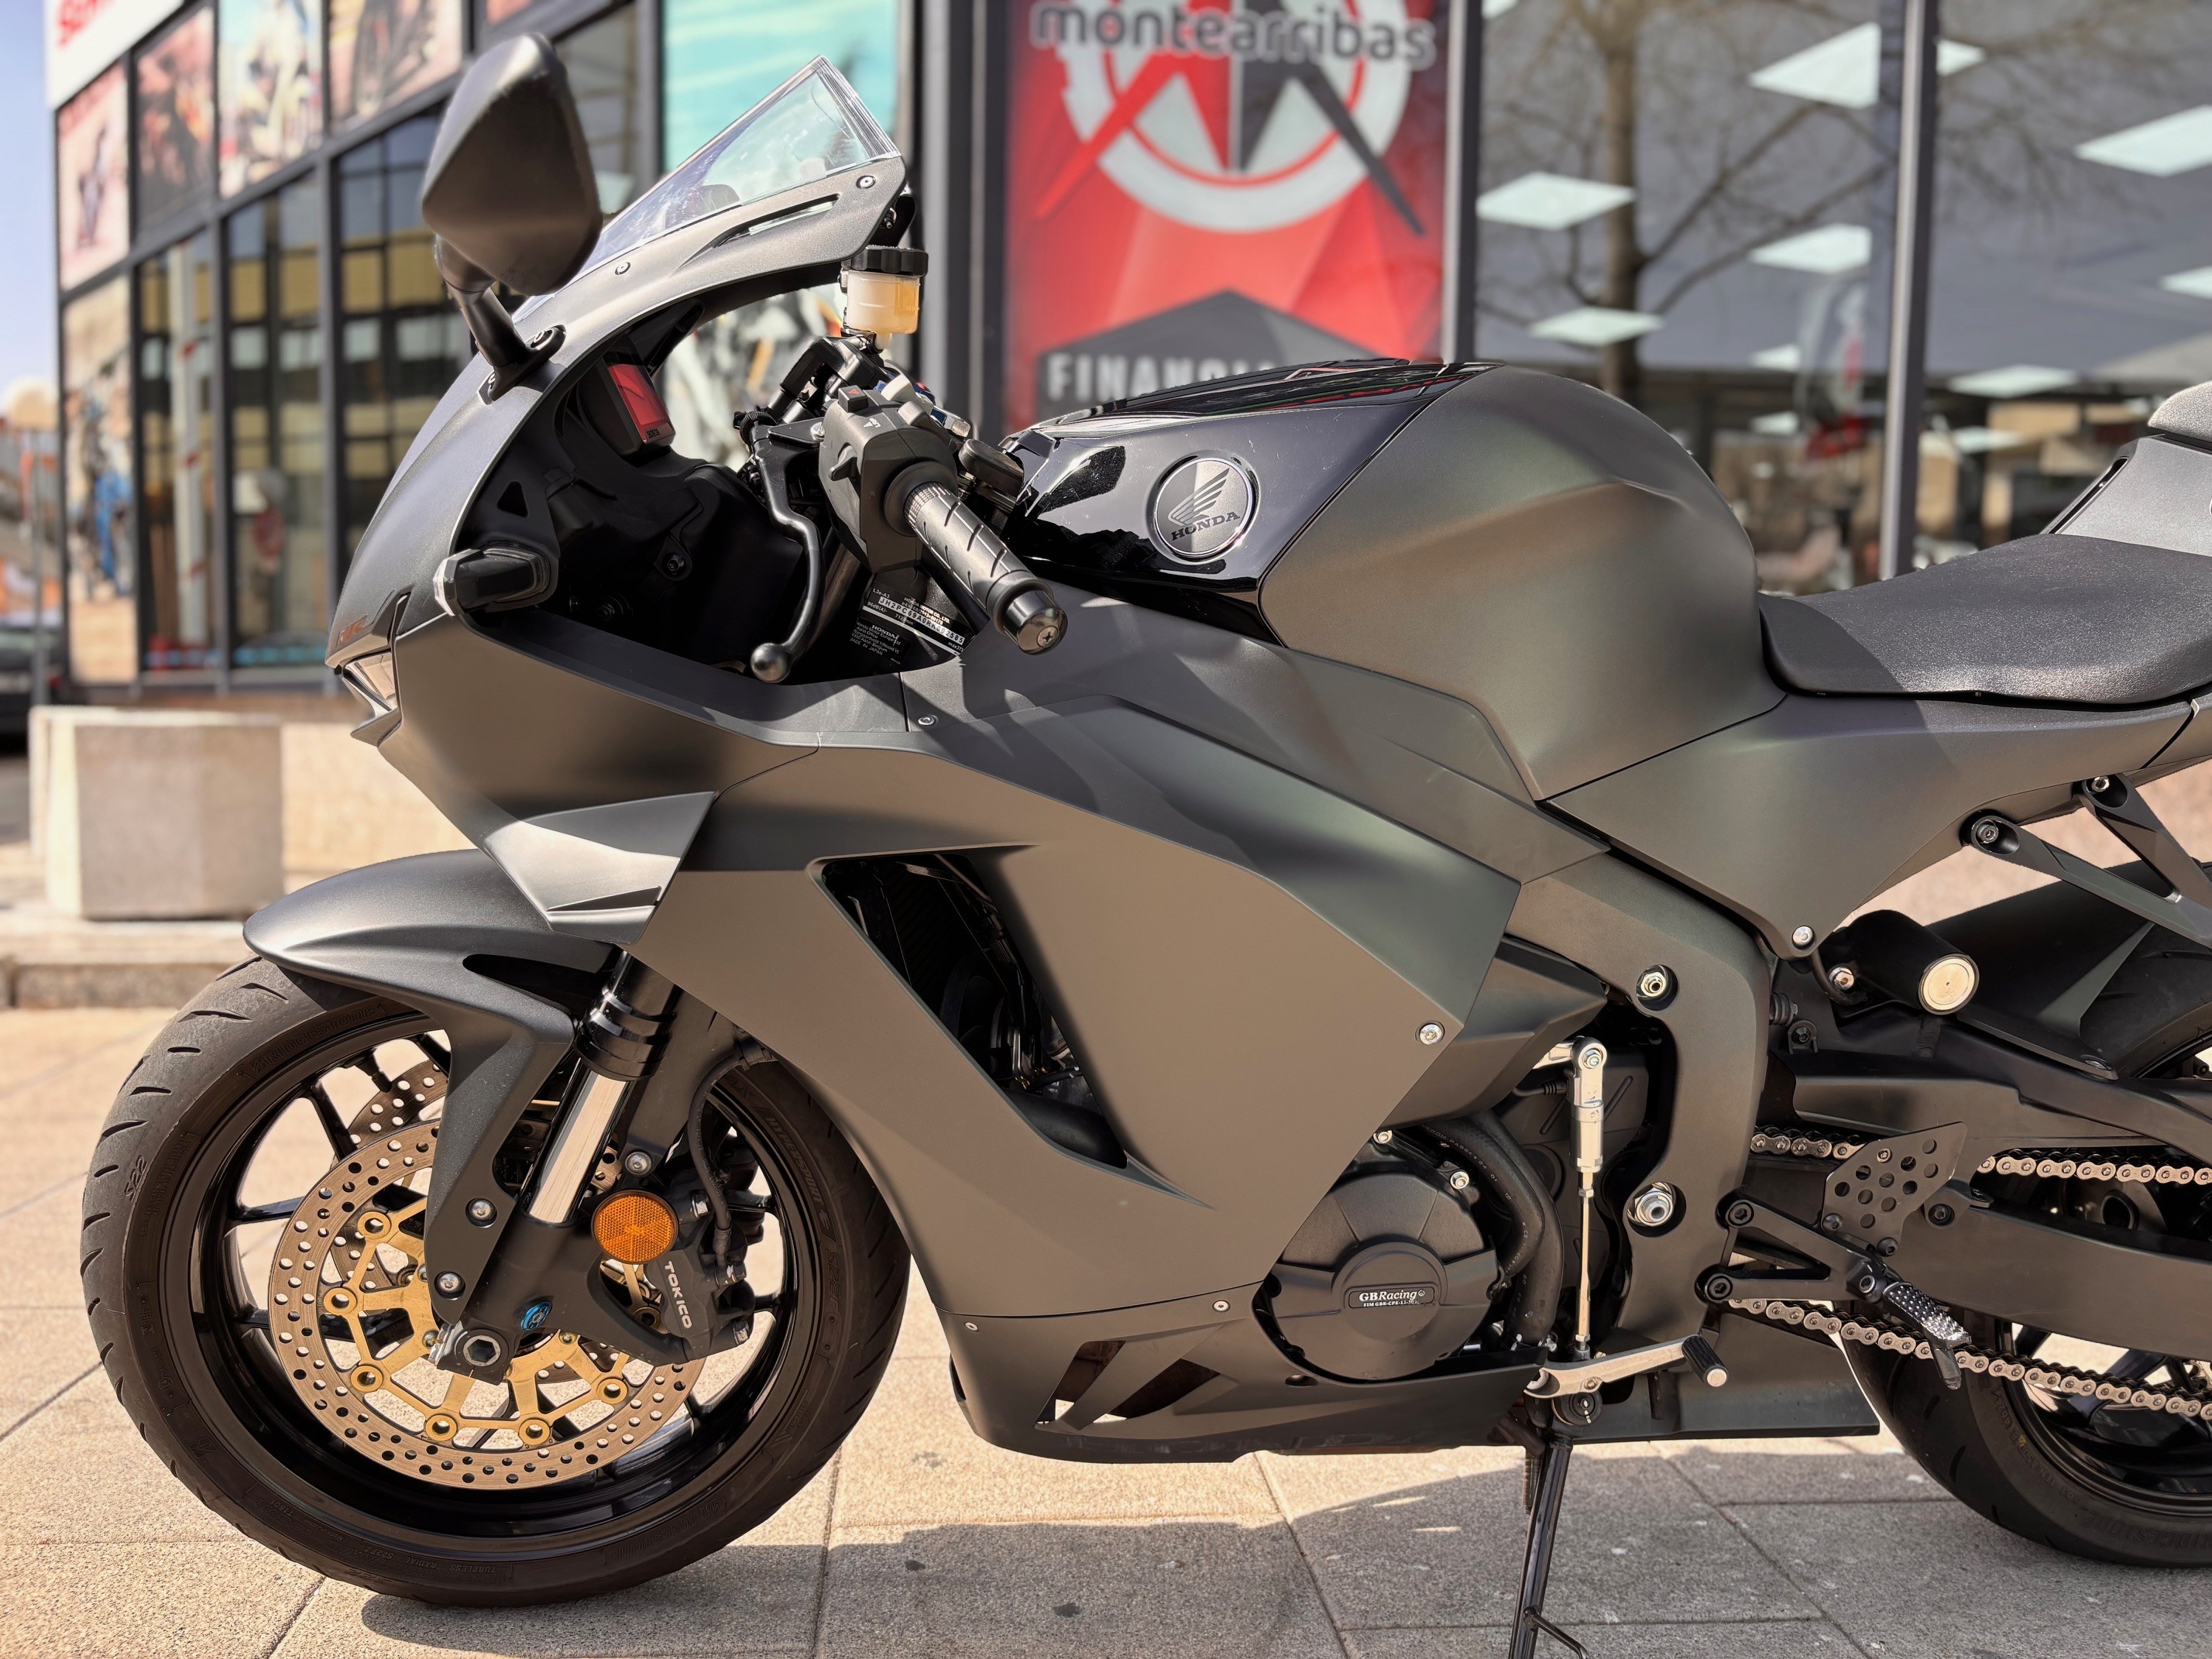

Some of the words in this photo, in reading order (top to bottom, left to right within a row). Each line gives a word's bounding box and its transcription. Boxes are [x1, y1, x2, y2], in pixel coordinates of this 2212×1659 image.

[1035, 2, 1433, 65] montearribas
[1171, 512, 1241, 541] HONDA
[871, 624, 895, 638] HONDA
[250, 1005, 376, 1074] BRIDGESTONE
[765, 1113, 823, 1207] HYPERSPORT
[665, 1261, 693, 1329] TOKICO
[1358, 1290, 1417, 1302] GBRacing
